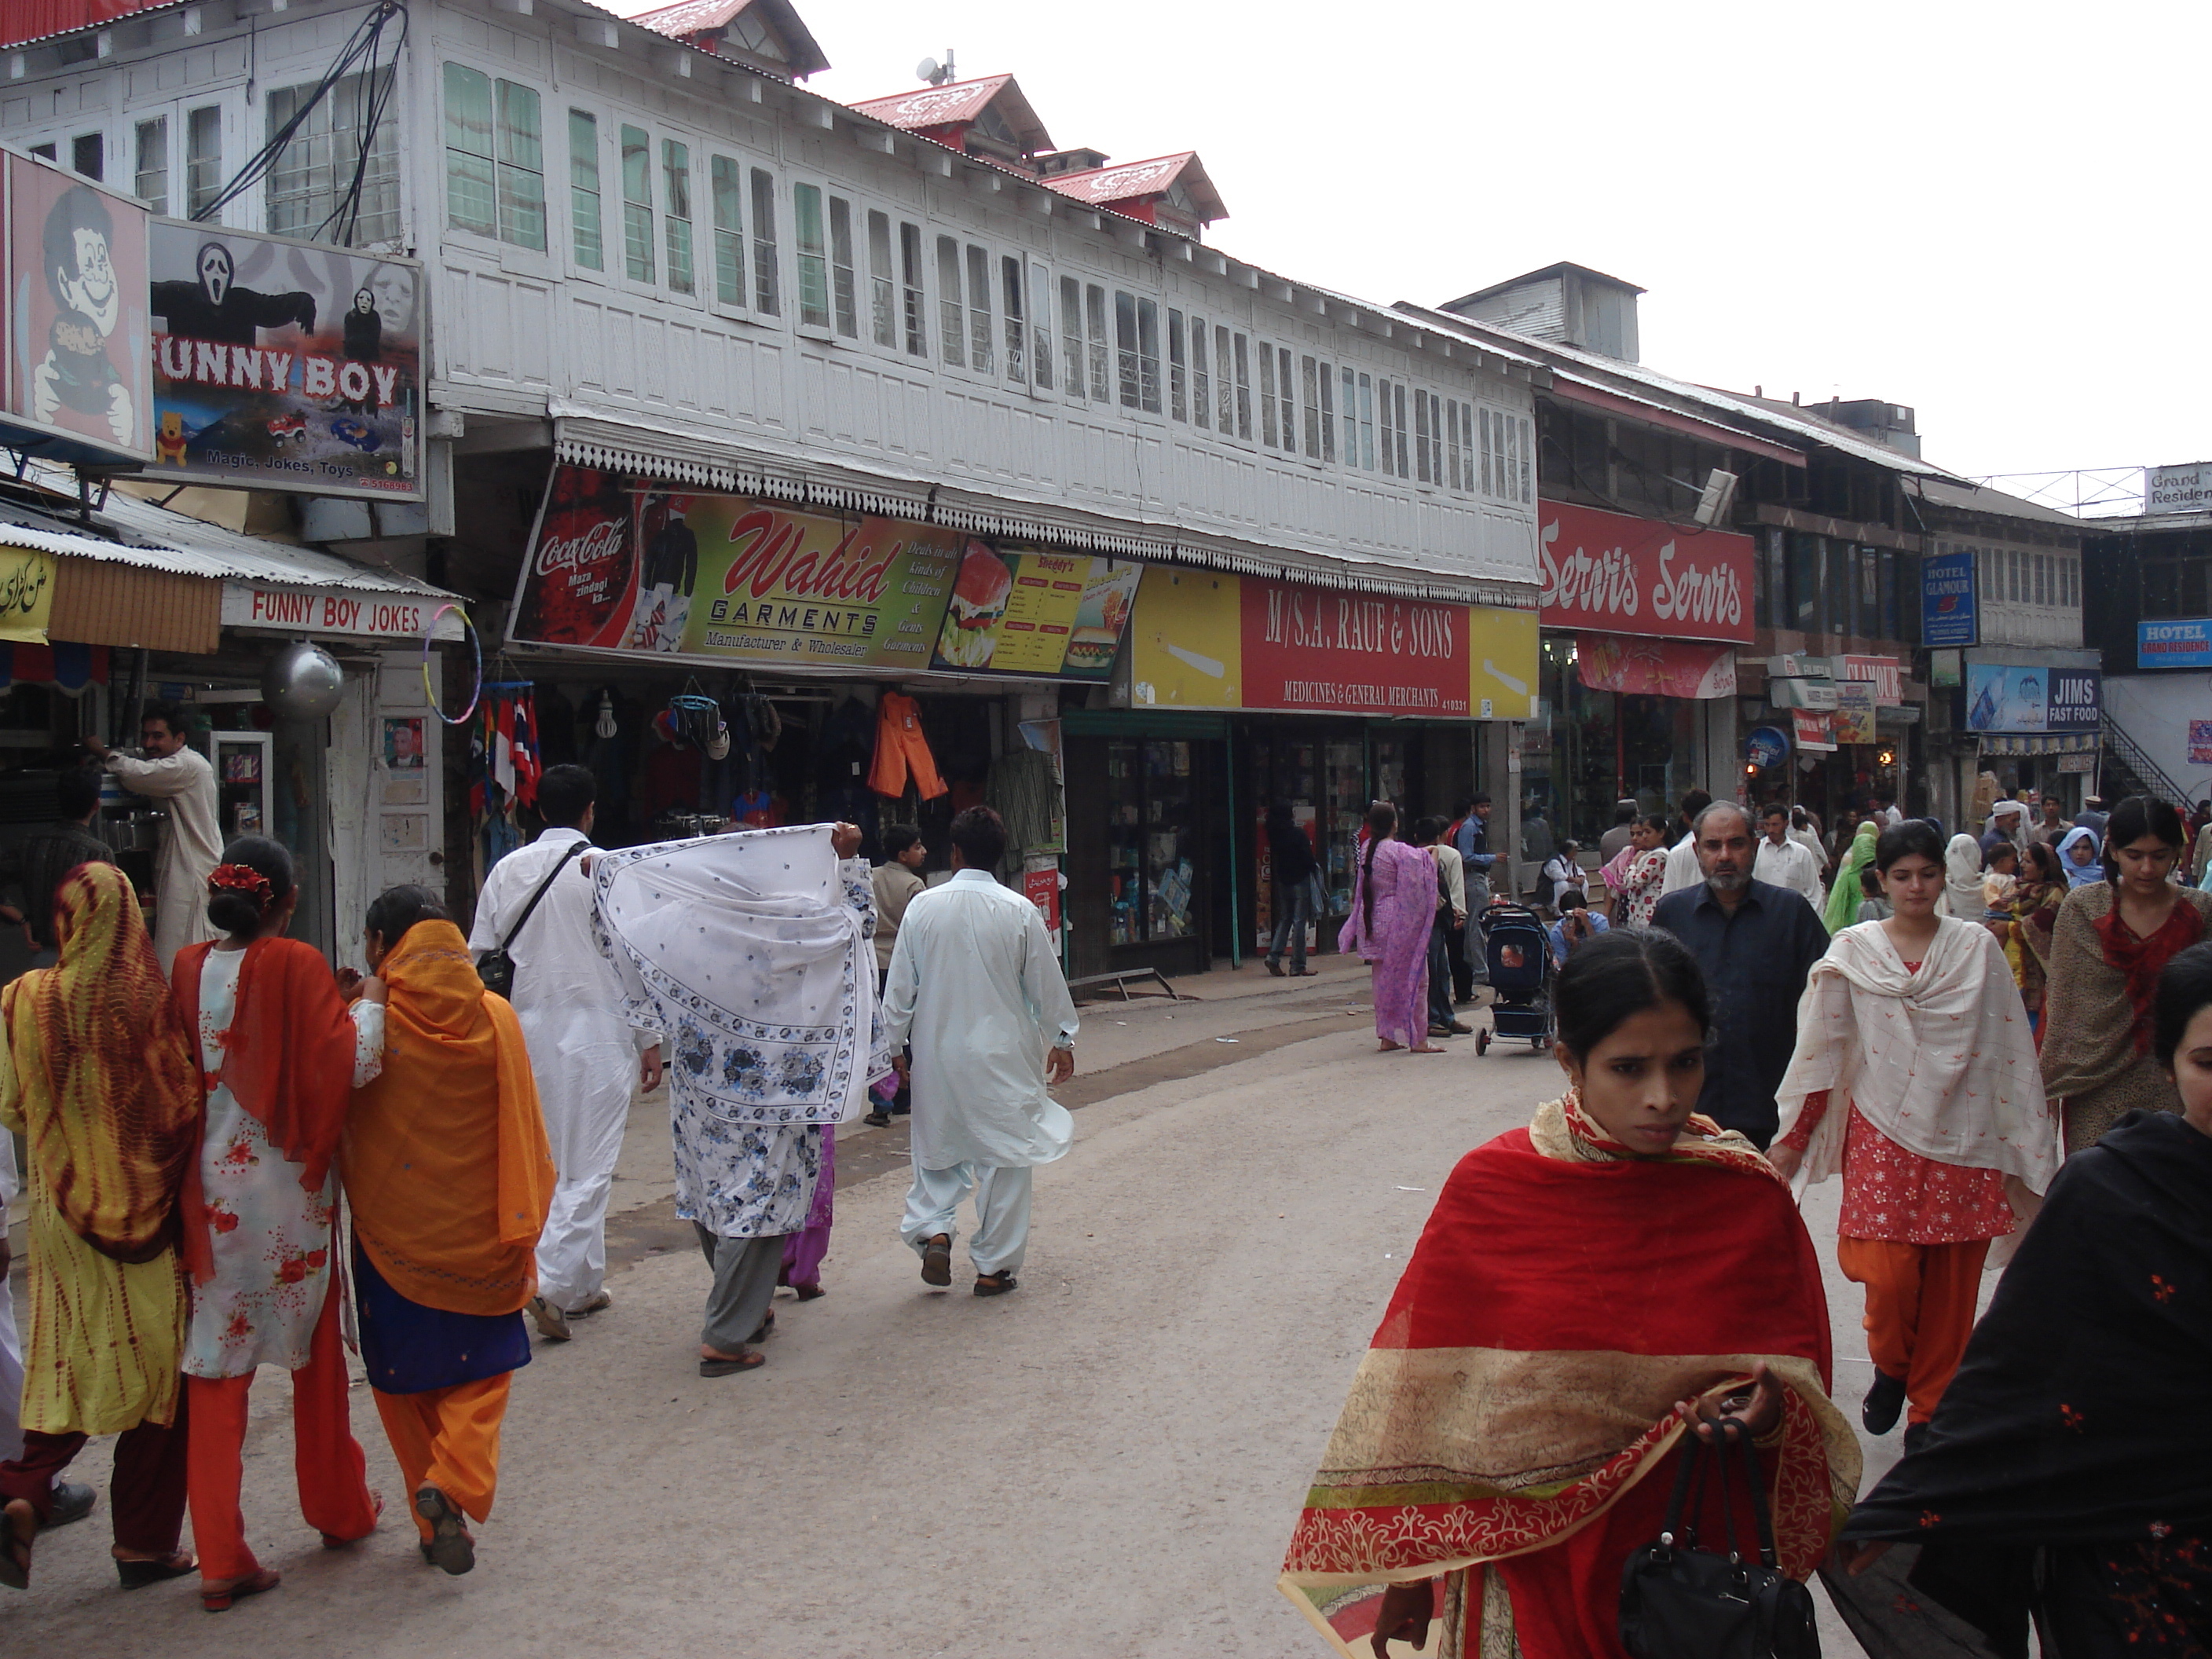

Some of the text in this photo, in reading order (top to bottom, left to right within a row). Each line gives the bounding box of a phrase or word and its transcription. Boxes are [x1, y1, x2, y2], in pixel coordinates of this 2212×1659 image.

[306, 356, 397, 405] BOY
[207, 449, 353, 478] Magic, Jokes, Toys
[2152, 472, 2199, 488] Grand
[537, 517, 628, 577] Coca-Cola
[907, 541, 958, 559] Deals in all
[724, 510, 903, 604] Wahid
[568, 573, 591, 588] Maza
[909, 561, 948, 581] kinds of
[1539, 518, 1741, 626] Servis Servis
[1928, 566, 1967, 580] HOTEL
[576, 577, 608, 598] zindagi
[903, 580, 941, 598] Children
[1926, 580, 1969, 595] GLAMOUR
[252, 591, 419, 632] FUNNY BOY JOKES
[710, 599, 877, 635] GARMENTS
[911, 601, 921, 615] &
[898, 619, 924, 635] Gents
[1337, 599, 1386, 653] RAUF
[1390, 603, 1403, 654] &
[1409, 607, 1453, 659] SONS
[2146, 625, 2206, 640] HOTEL
[705, 631, 869, 658] Manufacturer & Wholesaler
[884, 637, 926, 654] Garments
[2141, 640, 2210, 654] GRAND RESIDENCE
[1284, 680, 1438, 708] MEDICINES & GENERAL MERCHANTS
[2054, 679, 2093, 705] JIMS
[1441, 700, 1467, 712] 410331
[2049, 707, 2072, 722] FAST
[2074, 707, 2098, 722] FOOD
